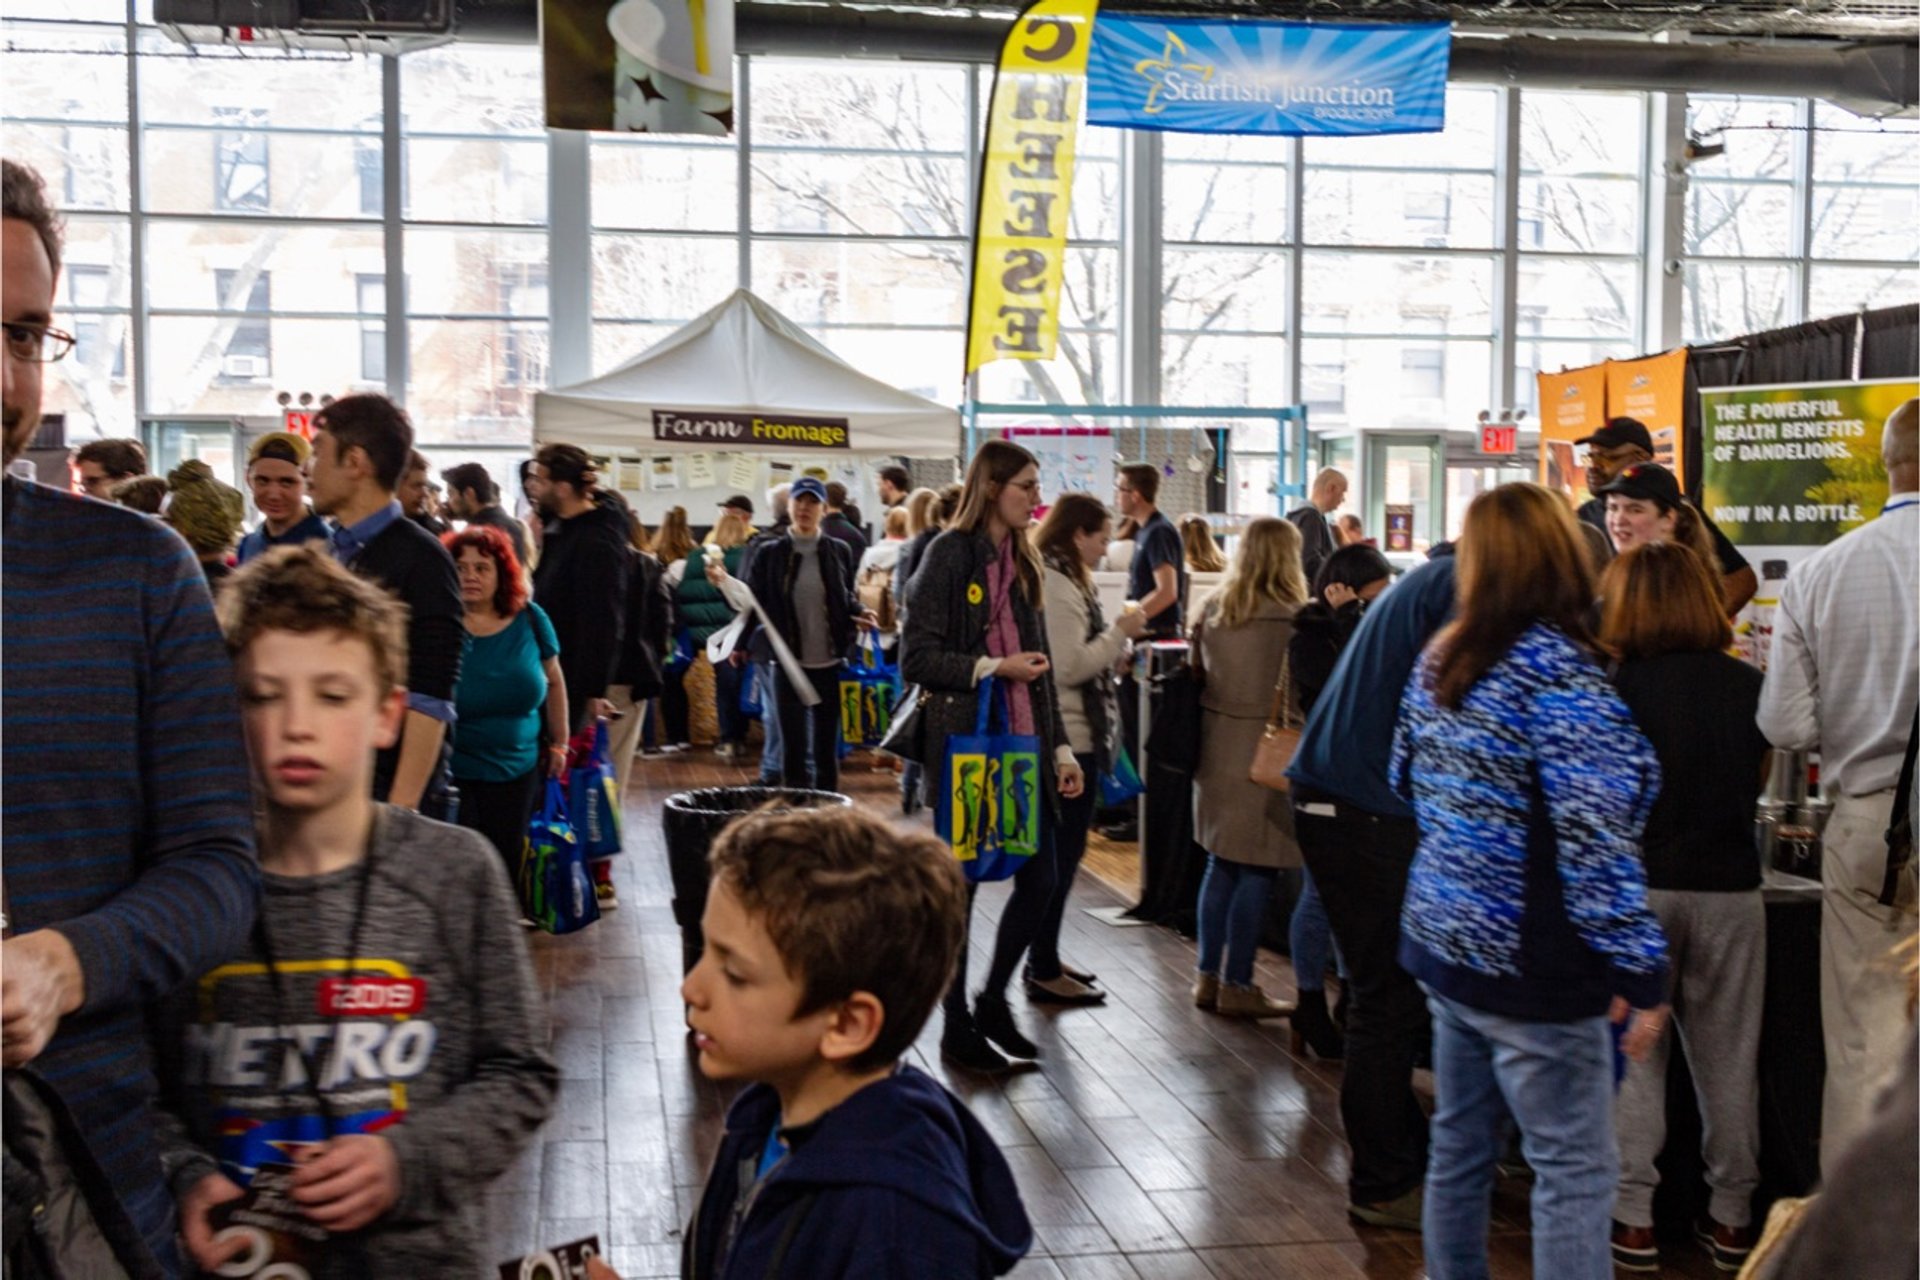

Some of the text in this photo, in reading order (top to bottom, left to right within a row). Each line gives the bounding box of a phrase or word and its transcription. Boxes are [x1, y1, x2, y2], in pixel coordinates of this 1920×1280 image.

[1162, 70, 1395, 109] Starfish Junction
[1714, 399, 1843, 422] THE POWERFUL
[656, 413, 846, 446] Farm Fromage
[1483, 427, 1516, 453] EXIT
[1714, 420, 1865, 442] HEALTH BENEFITS
[1713, 442, 1853, 462] OF DANDELIONS.
[1713, 504, 1866, 523] NOW IN A BOTTLE.
